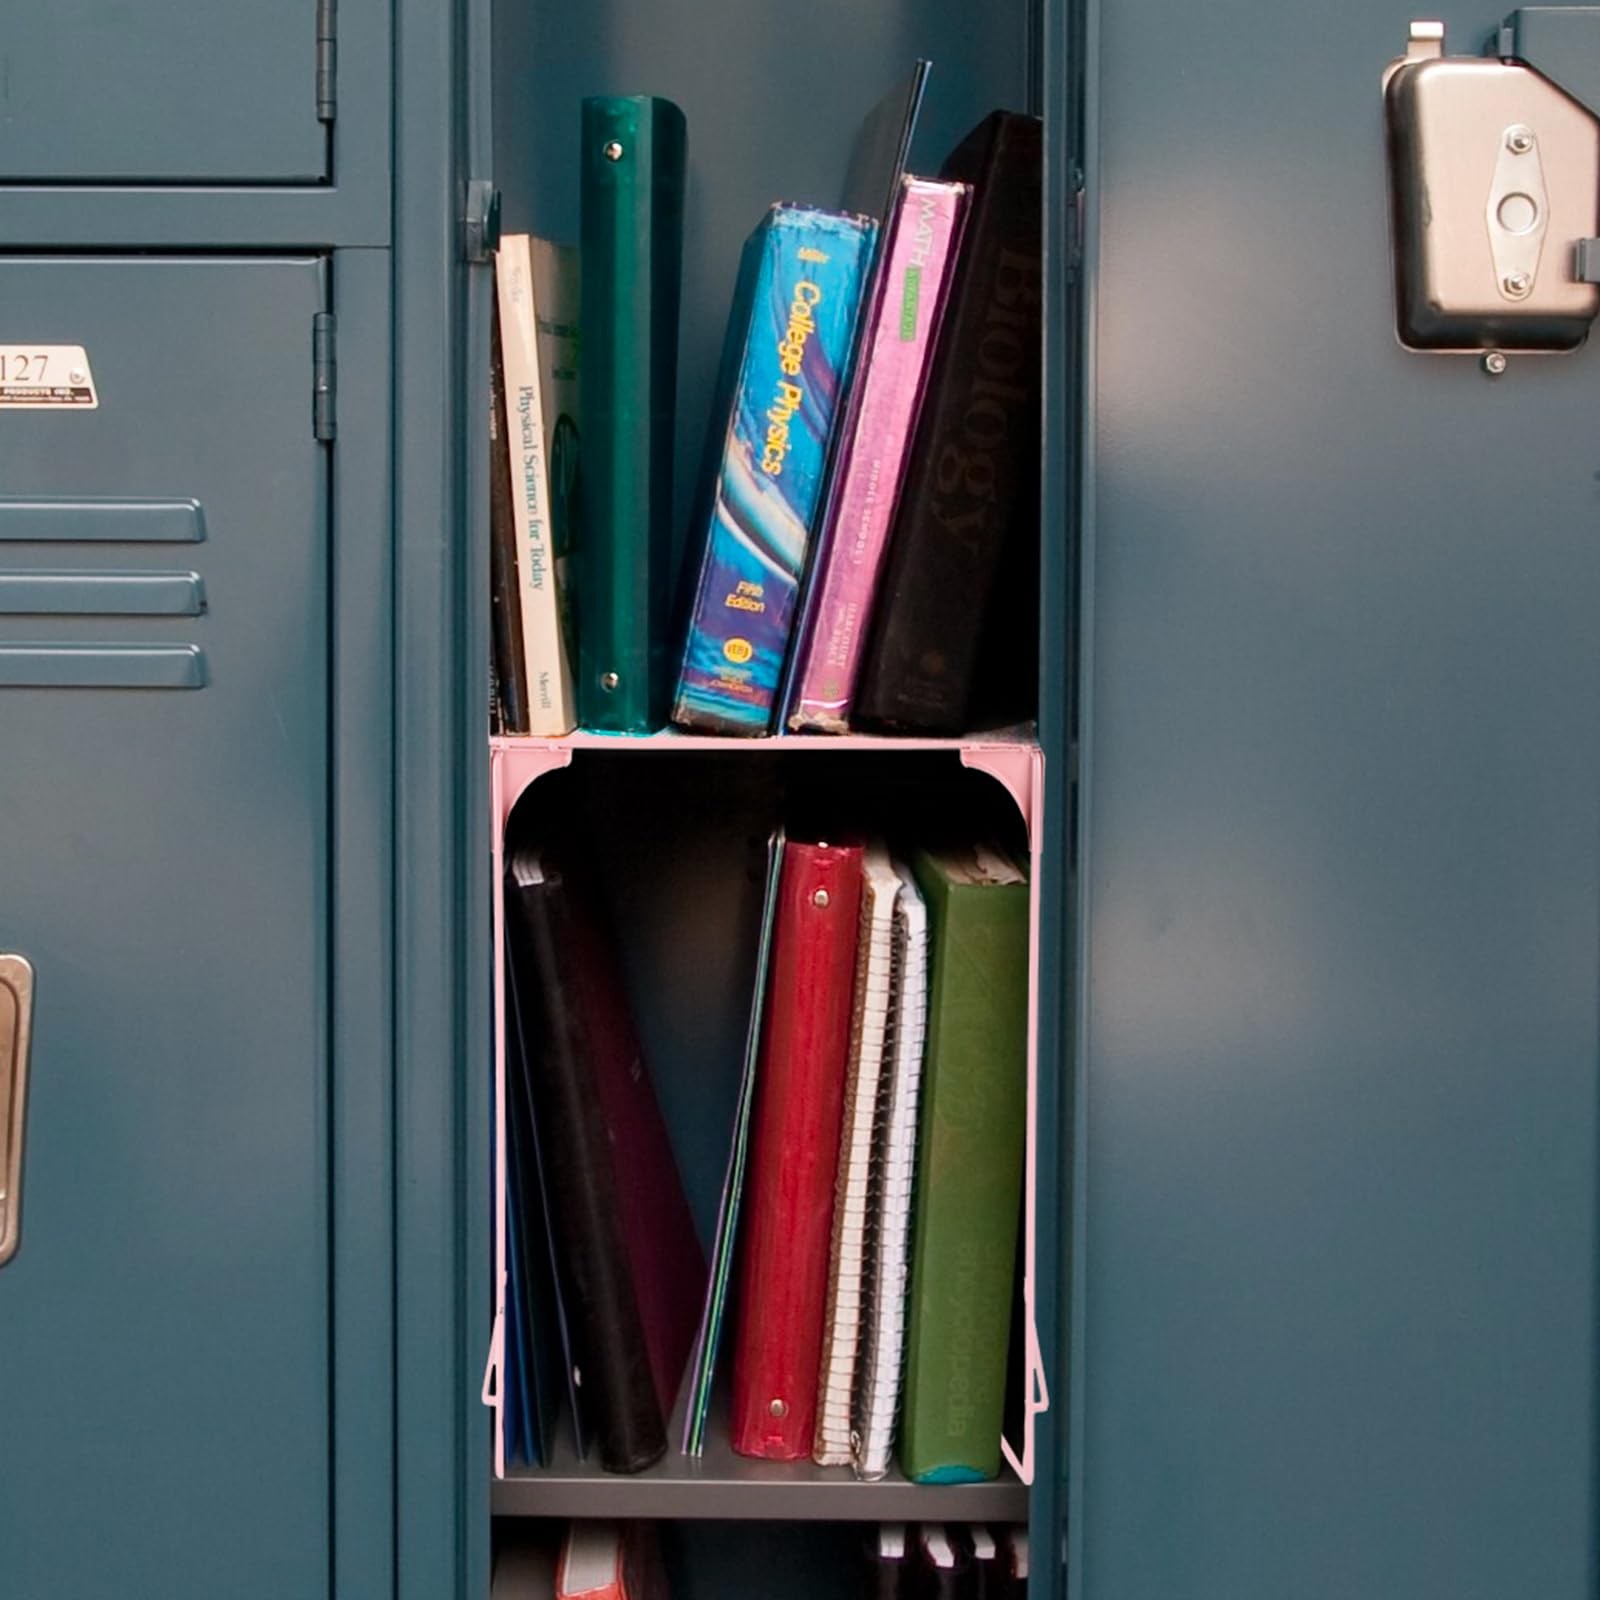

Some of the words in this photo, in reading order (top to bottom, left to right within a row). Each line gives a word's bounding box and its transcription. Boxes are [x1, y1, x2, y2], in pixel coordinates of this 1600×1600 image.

[908, 198, 937, 267] MATH
[779, 280, 820, 376] College
[0, 354, 49, 382] 127
[517, 386, 538, 450] Physical
[762, 380, 802, 475] Physics
[523, 454, 539, 515] Science
[528, 518, 543, 539] for
[529, 542, 547, 591] Today
[536, 671, 552, 709] Merrill
